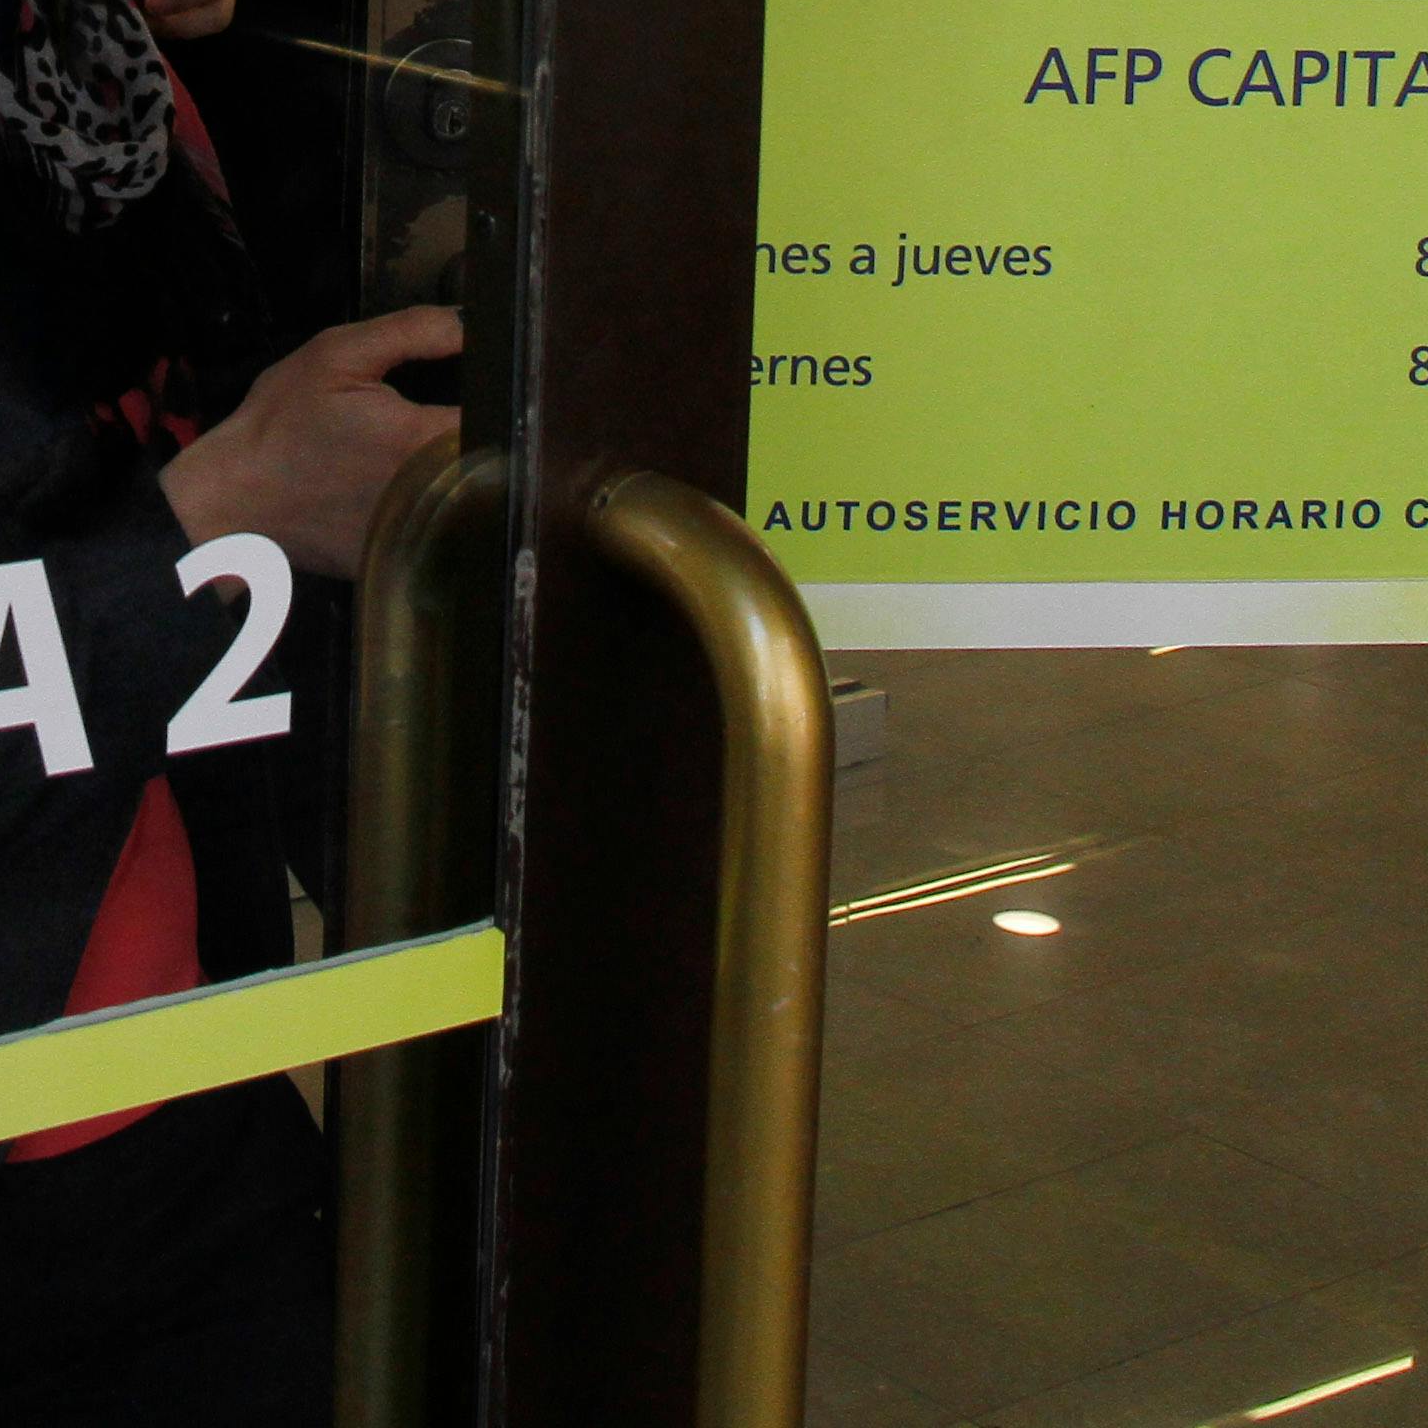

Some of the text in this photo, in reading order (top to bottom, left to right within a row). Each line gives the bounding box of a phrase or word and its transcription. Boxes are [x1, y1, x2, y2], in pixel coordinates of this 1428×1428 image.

[1023, 46, 1164, 106] AFP
[849, 243, 876, 275] a
[891, 232, 1053, 287] jueves
[762, 499, 1138, 532] AUTOSERVICIO
[1160, 498, 1382, 531] HORARIO
[165, 532, 295, 756] 2
